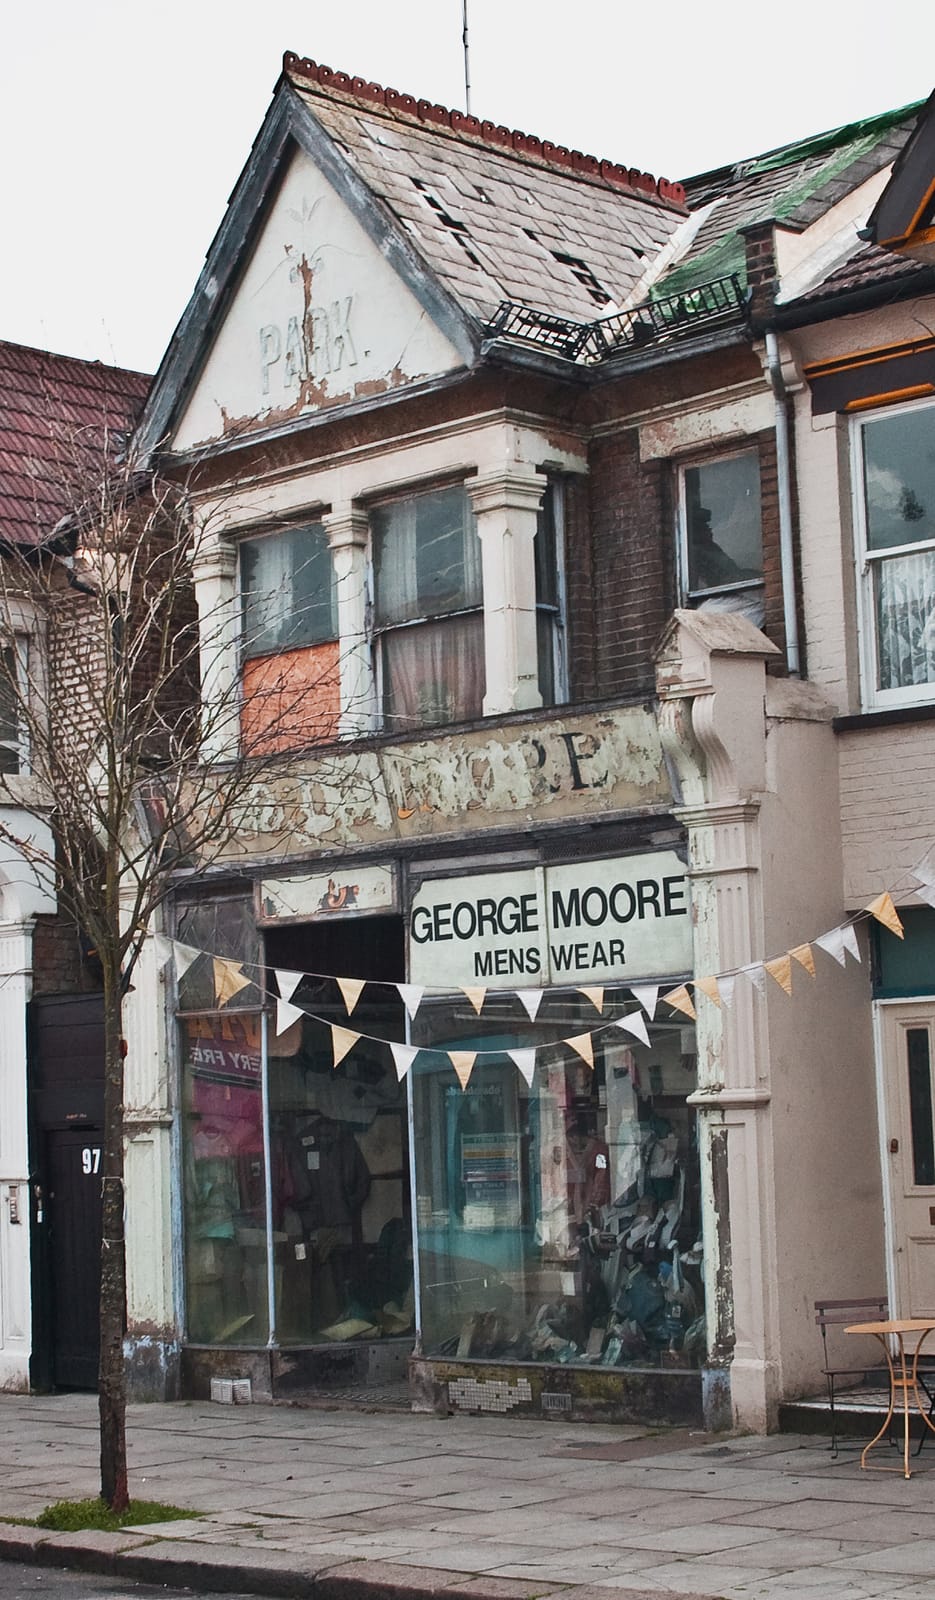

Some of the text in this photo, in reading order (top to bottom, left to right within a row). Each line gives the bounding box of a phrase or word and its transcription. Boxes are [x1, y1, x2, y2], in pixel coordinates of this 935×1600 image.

[411, 893, 539, 943] GEORGE
[552, 875, 687, 929] MOORE
[474, 939, 626, 977] MENS WEAR
[82, 1147, 101, 1174] 97
